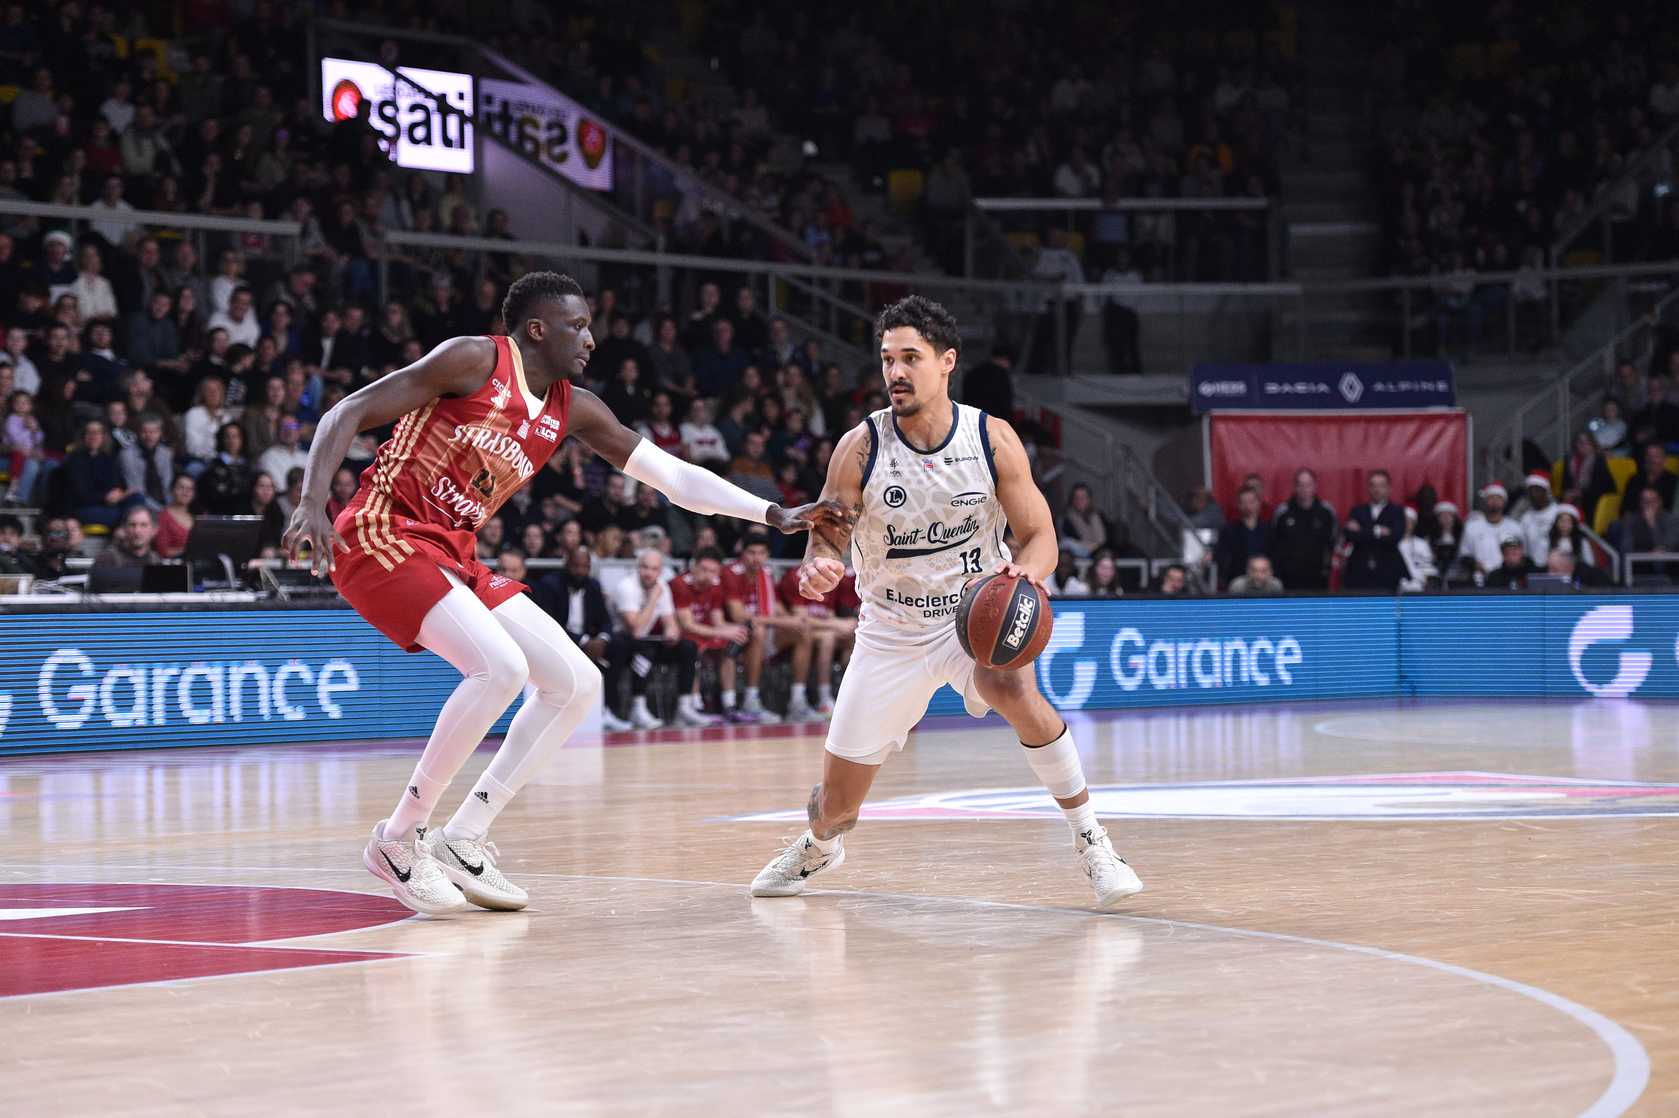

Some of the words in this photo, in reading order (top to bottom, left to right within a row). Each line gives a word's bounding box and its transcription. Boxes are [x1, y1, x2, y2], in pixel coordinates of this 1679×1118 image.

[448, 425, 535, 481] STRASBOUR
[884, 514, 978, 546] Saint-Quentin
[959, 547, 983, 575] 13
[886, 588, 959, 608] E.Leclerc
[1006, 598, 1033, 648] Betclic
[1110, 627, 1303, 691] Garance
[38, 648, 360, 729] Garance
